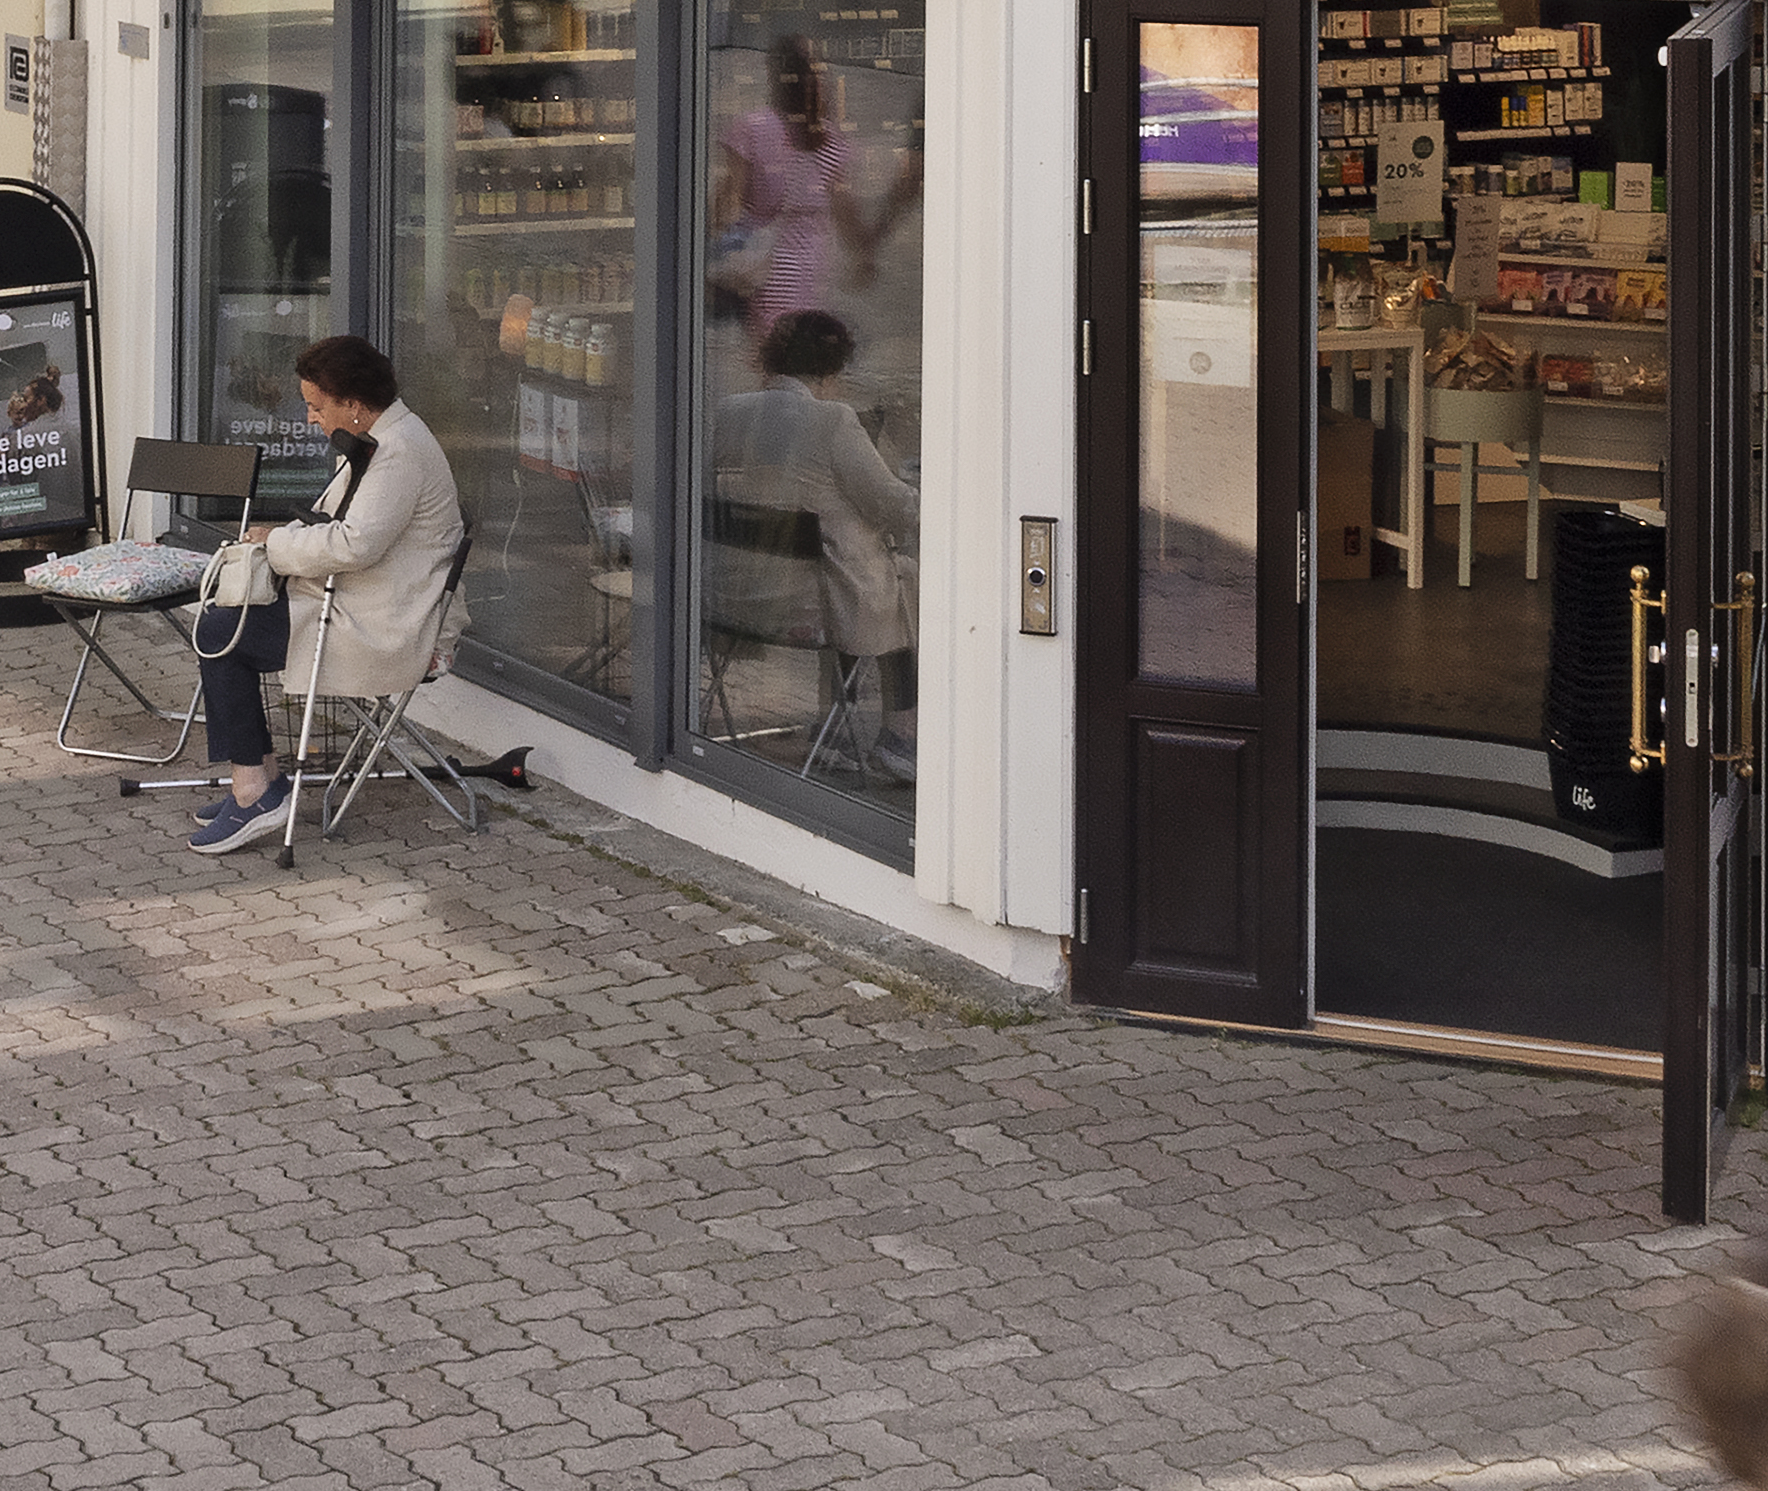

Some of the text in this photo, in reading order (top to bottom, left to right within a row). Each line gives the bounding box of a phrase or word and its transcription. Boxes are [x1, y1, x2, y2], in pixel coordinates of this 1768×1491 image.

[1384, 162, 1424, 180] 20%
[51, 310, 72, 329] life
[16, 428, 61, 451] leve
[1572, 784, 1596, 811] life
